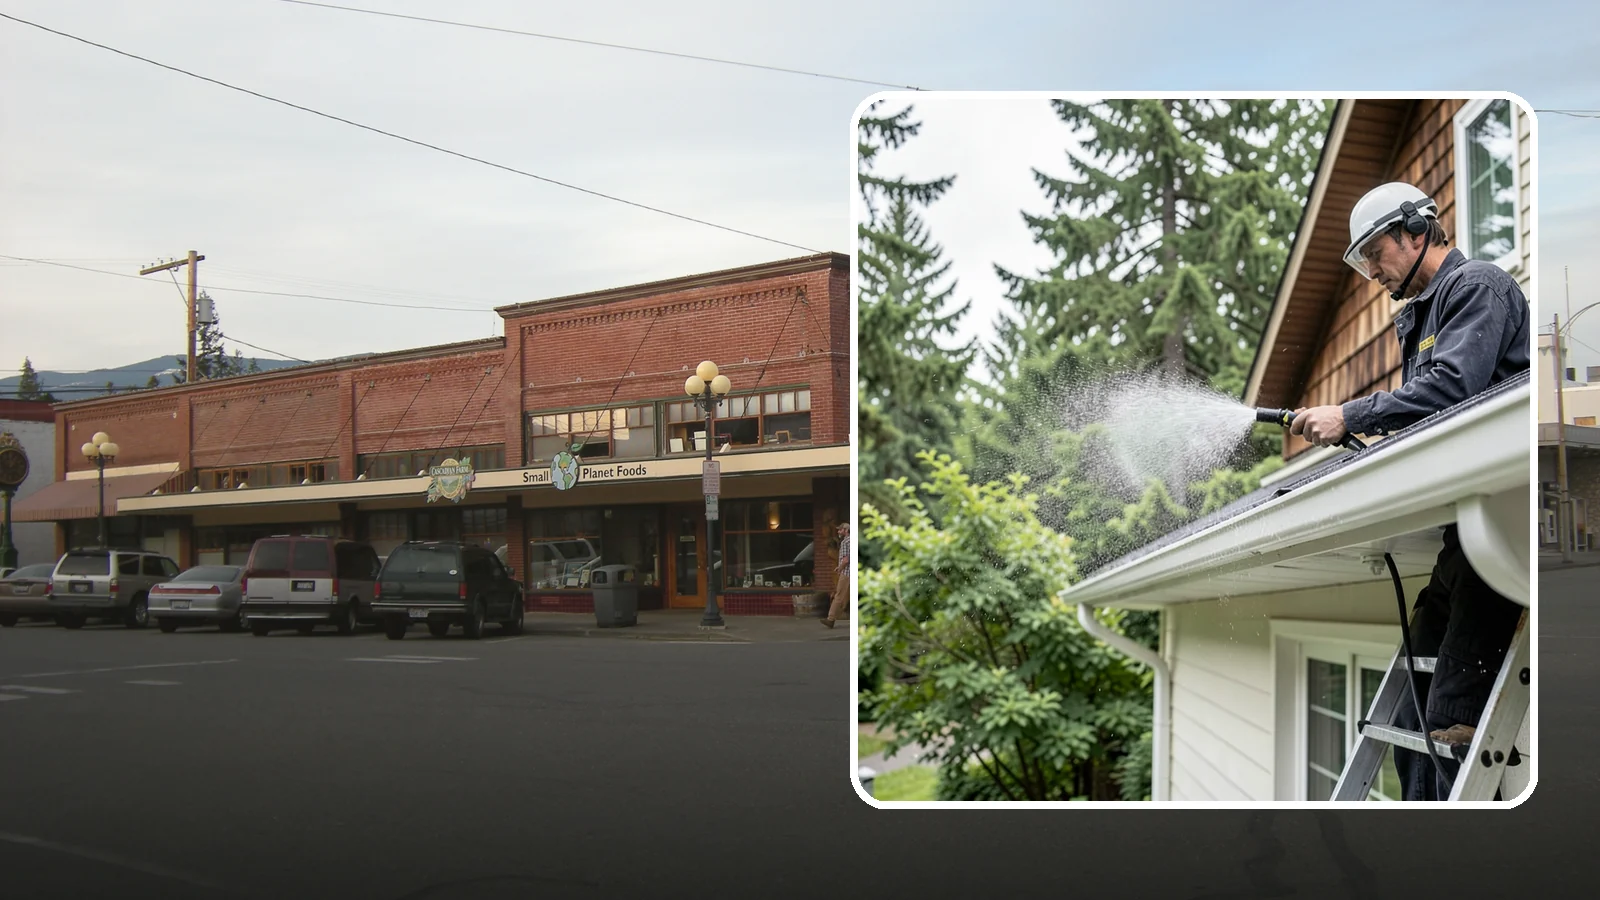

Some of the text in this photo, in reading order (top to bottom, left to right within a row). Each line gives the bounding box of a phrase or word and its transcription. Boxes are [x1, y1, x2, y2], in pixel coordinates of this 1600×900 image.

[523, 464, 647, 483] Small Planet Foods
